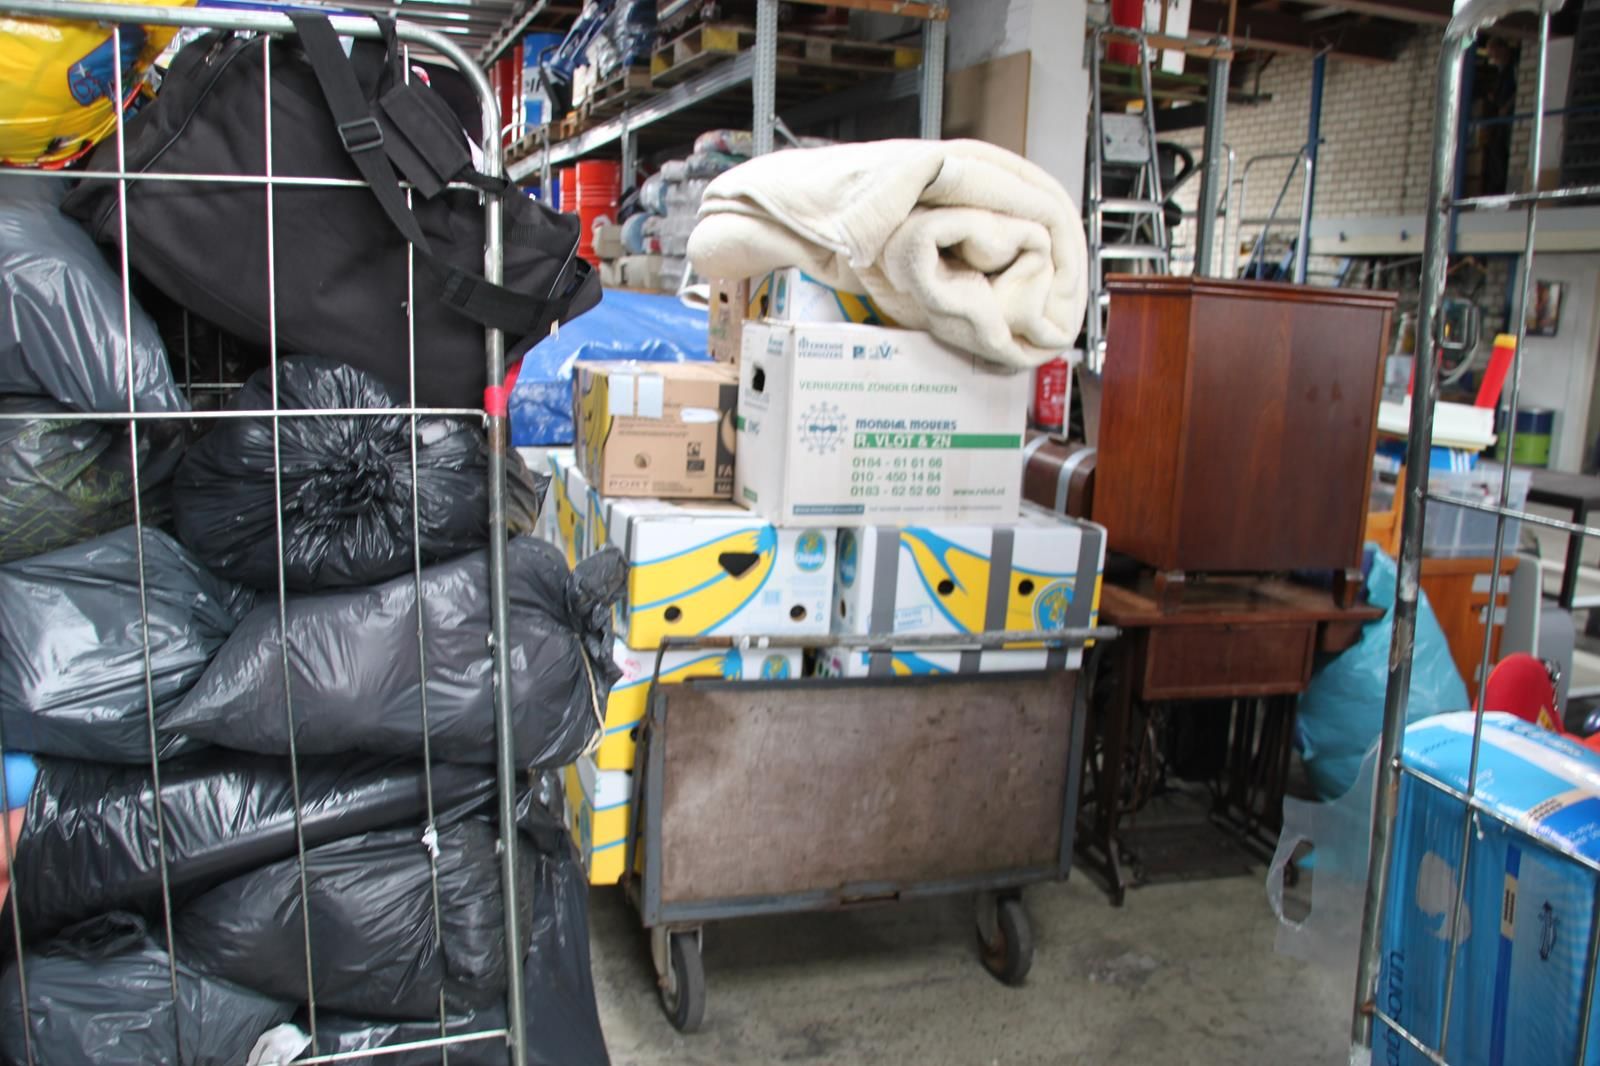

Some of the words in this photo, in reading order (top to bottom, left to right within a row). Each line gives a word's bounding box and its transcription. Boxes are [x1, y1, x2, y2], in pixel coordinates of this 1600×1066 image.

[799, 380, 865, 392] VERHUIZERS
[867, 381, 909, 393] ZONDER
[911, 383, 958, 394] GRENZEN
[875, 434, 914, 449] VLOT
[931, 435, 952, 449] ZN
[851, 471, 874, 483] 010
[912, 471, 924, 482] 14
